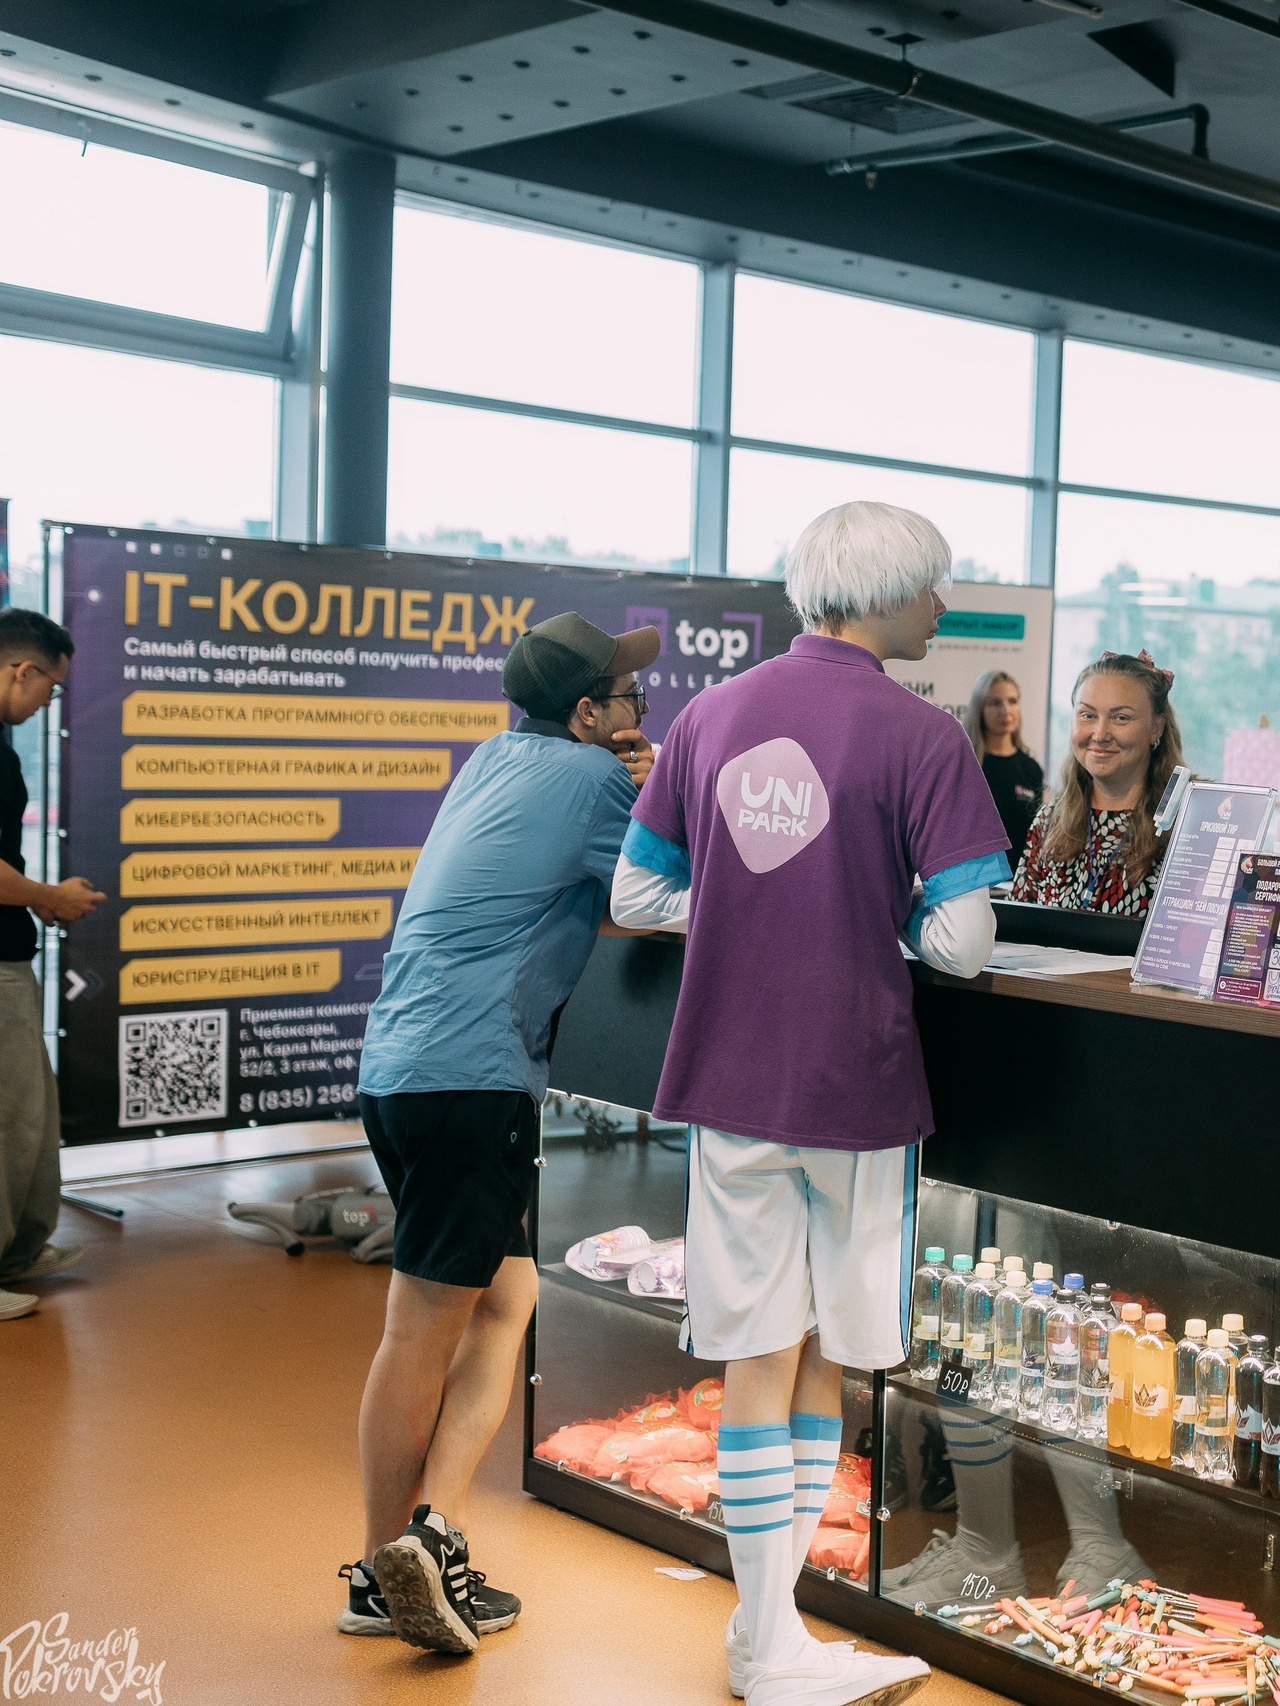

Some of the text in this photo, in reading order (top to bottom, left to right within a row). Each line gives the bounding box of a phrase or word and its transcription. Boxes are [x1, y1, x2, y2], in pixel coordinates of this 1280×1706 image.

[124, 571, 535, 653] IT-КОЛЛЕДЖ
[124, 637, 506, 675] Самый быстрый способ получить профес
[675, 620, 749, 669] top
[124, 664, 346, 688] и начать зарабатывать
[136, 703, 497, 727] РАЗРАБОТКА ПРОГРАММНОГО ОБЕСПЕЧЕНИЯ
[135, 758, 441, 777] КОМПЬЮТЕРНАЯ ГРАФИКА И ДИЗАЙН
[740, 772, 813, 817] UNI
[134, 809, 325, 827] КИБЕРБЕЗОПАСНОСТЬ
[737, 808, 808, 838] PARK
[1200, 821, 1227, 833] ПРИЗОВОЙ
[132, 860, 411, 882] ЦИФРОВОЙ МАРКЕТИНГ, МЕДИА И
[1162, 896, 1194, 910] АТТРАКЦИОН
[132, 908, 381, 934] ИСКУССТВЕННЫЙ ИНТЕЛЛЕКТ
[132, 960, 321, 988] ЮРИСПРУДЕНЦИЯ В IT
[239, 1006, 314, 1025] Приемная
[253, 1022, 340, 1041] Чебоксары,
[239, 1037, 364, 1062] ул. Карла Маркса
[280, 1059, 291, 1074] 3
[292, 1057, 334, 1073] этаж,
[239, 1093, 254, 1113] 8
[258, 1085, 313, 1112] (835)
[343, 1209, 369, 1228] top
[941, 1369, 969, 1395] 50₽
[960, 1572, 996, 1600] 150₽
